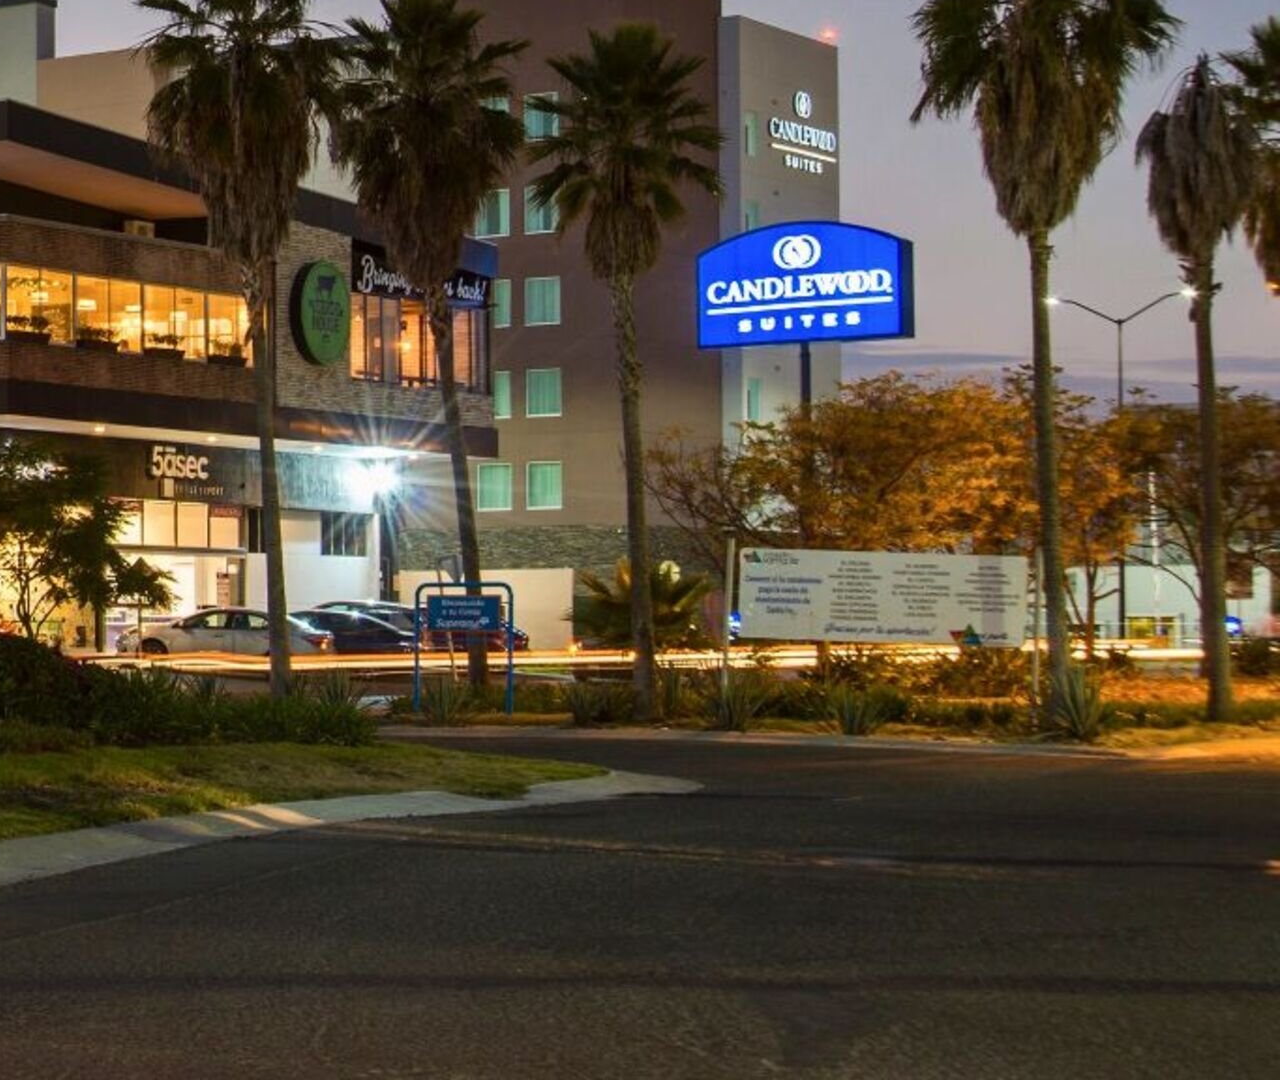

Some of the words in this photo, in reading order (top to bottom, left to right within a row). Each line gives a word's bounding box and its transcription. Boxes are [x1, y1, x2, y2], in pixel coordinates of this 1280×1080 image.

[769, 117, 837, 152] CANDLEWOOD
[784, 153, 823, 174] SUITES
[706, 269, 891, 304] CANDLEWOOD
[738, 311, 861, 333] SUITES
